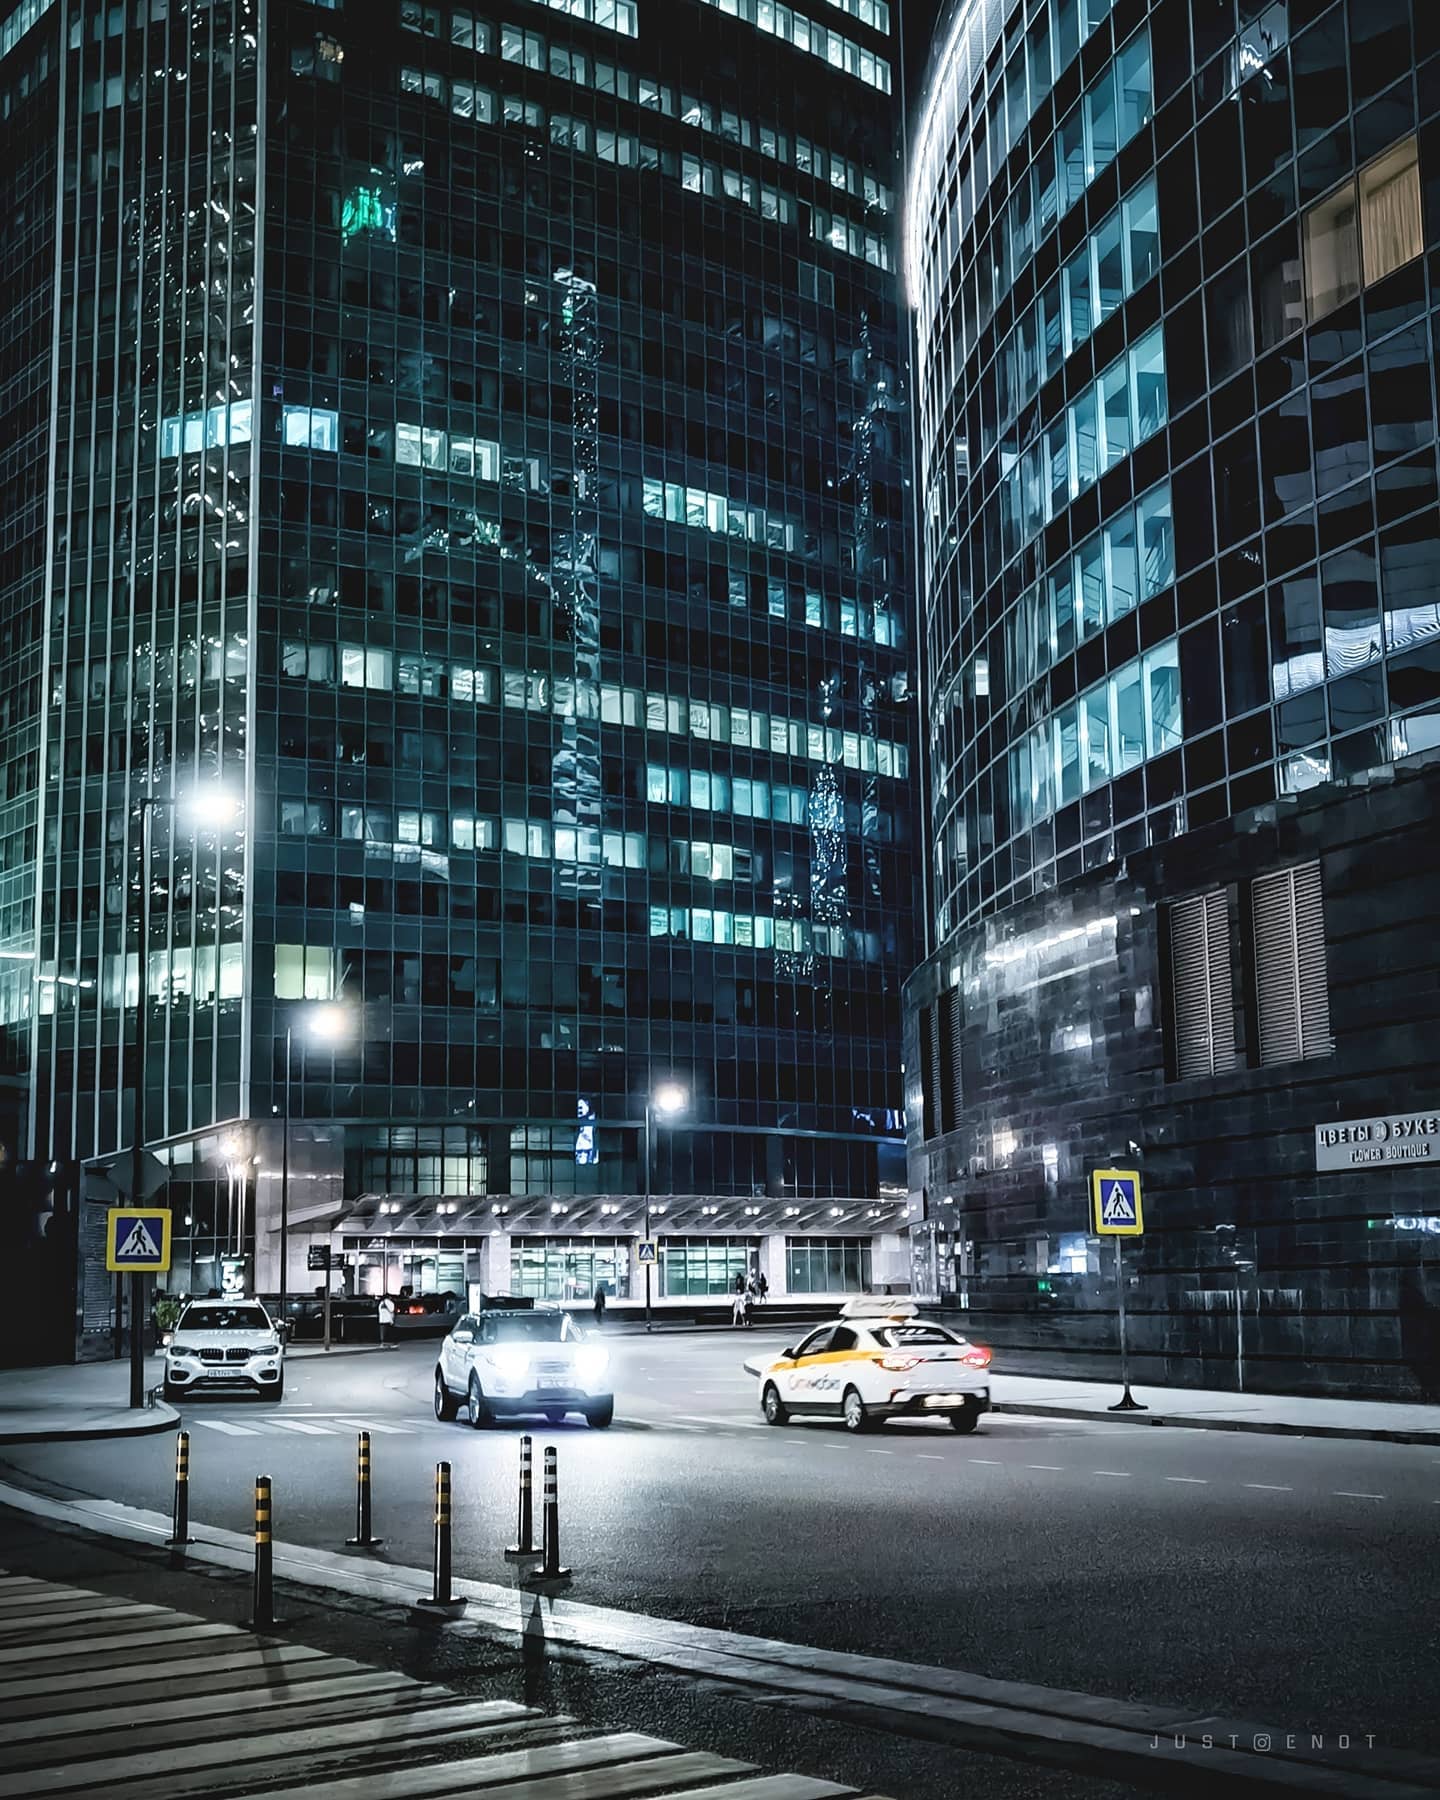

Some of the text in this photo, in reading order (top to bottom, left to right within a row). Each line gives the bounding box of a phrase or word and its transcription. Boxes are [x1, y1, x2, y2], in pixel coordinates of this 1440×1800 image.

[1319, 1124, 1370, 1147] ЦВЕТЫ
[1392, 1117, 1440, 1138] БУКЕ
[1349, 1142, 1429, 1162] FLOWER BOUTIQUE
